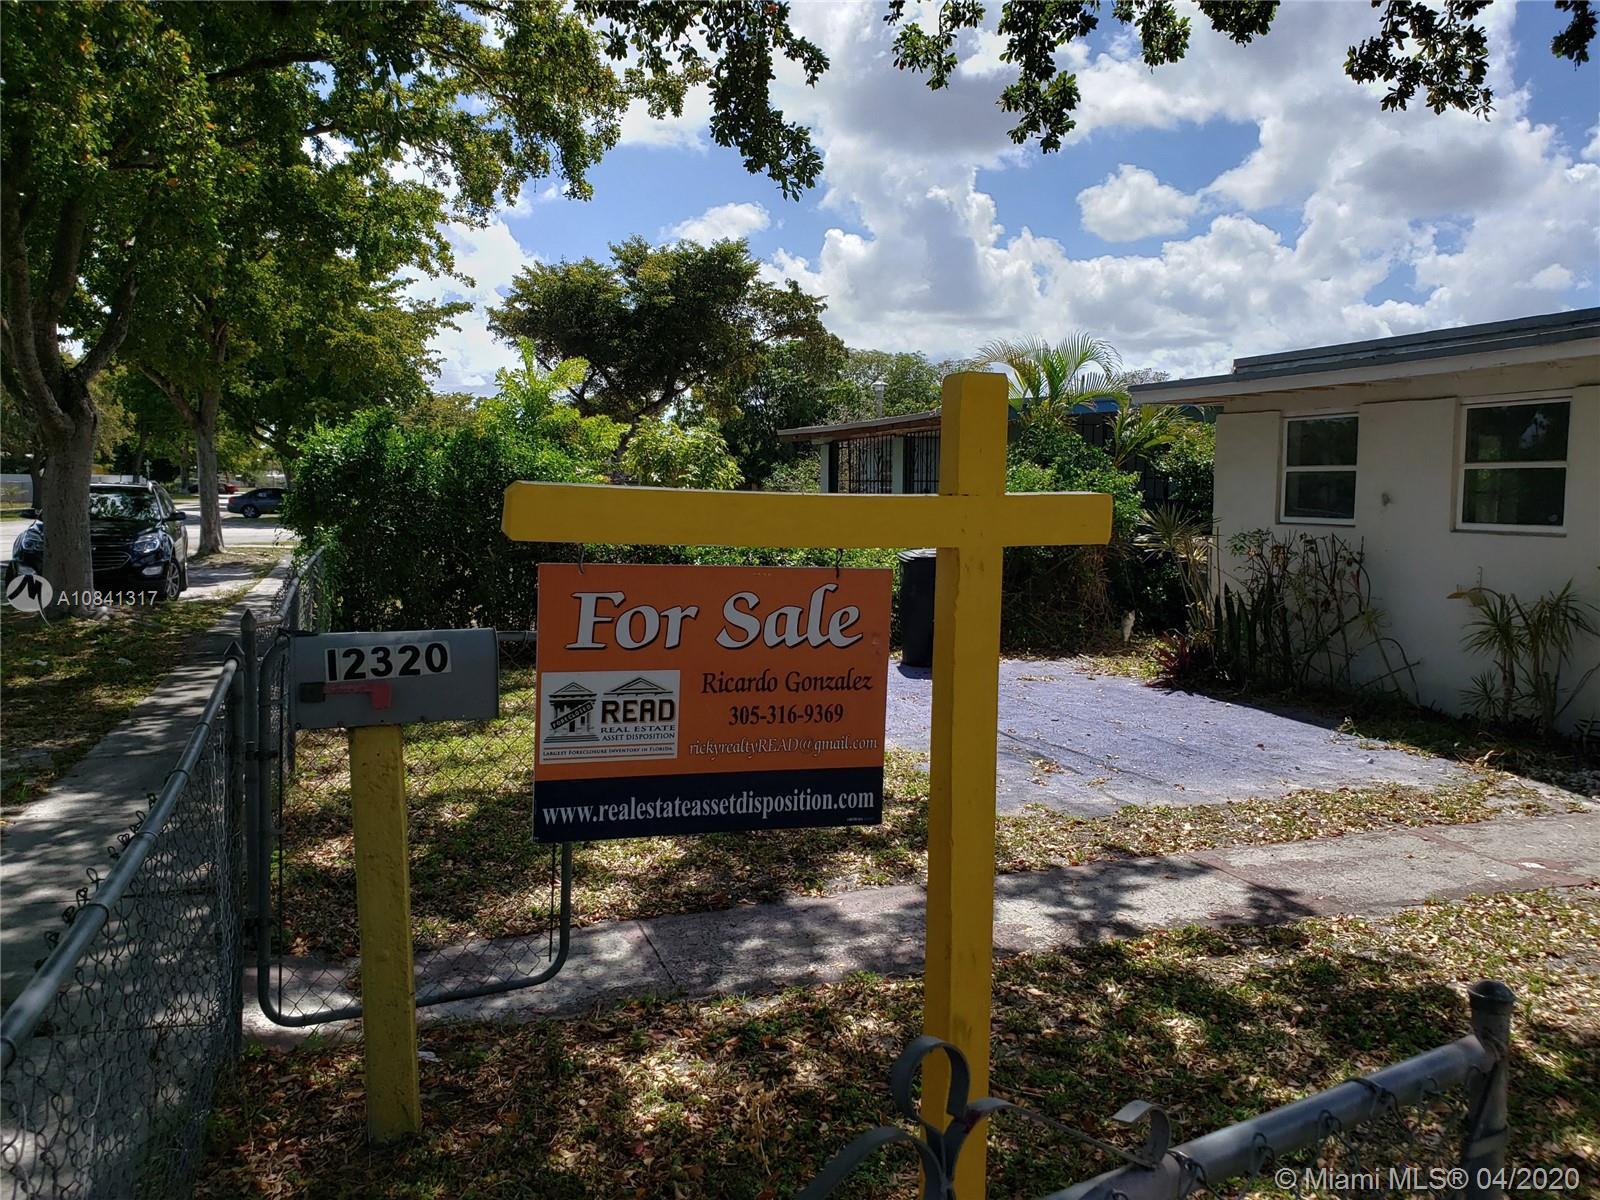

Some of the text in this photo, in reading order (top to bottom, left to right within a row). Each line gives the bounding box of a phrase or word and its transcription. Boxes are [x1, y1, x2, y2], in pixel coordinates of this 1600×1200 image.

[565, 583, 864, 651] For Sale
[326, 642, 449, 681] 12320
[701, 667, 873, 694] Ricardo Gonzalez
[601, 699, 676, 724] READ
[728, 703, 844, 726] 305-316-9369
[600, 724, 676, 734] REAL ESTATE
[626, 732, 676, 741] DISPOSITION
[689, 735, 878, 760] rickyrealtyREAD@gmail.com
[542, 789, 875, 825] www.realestateassetdisposition.com
